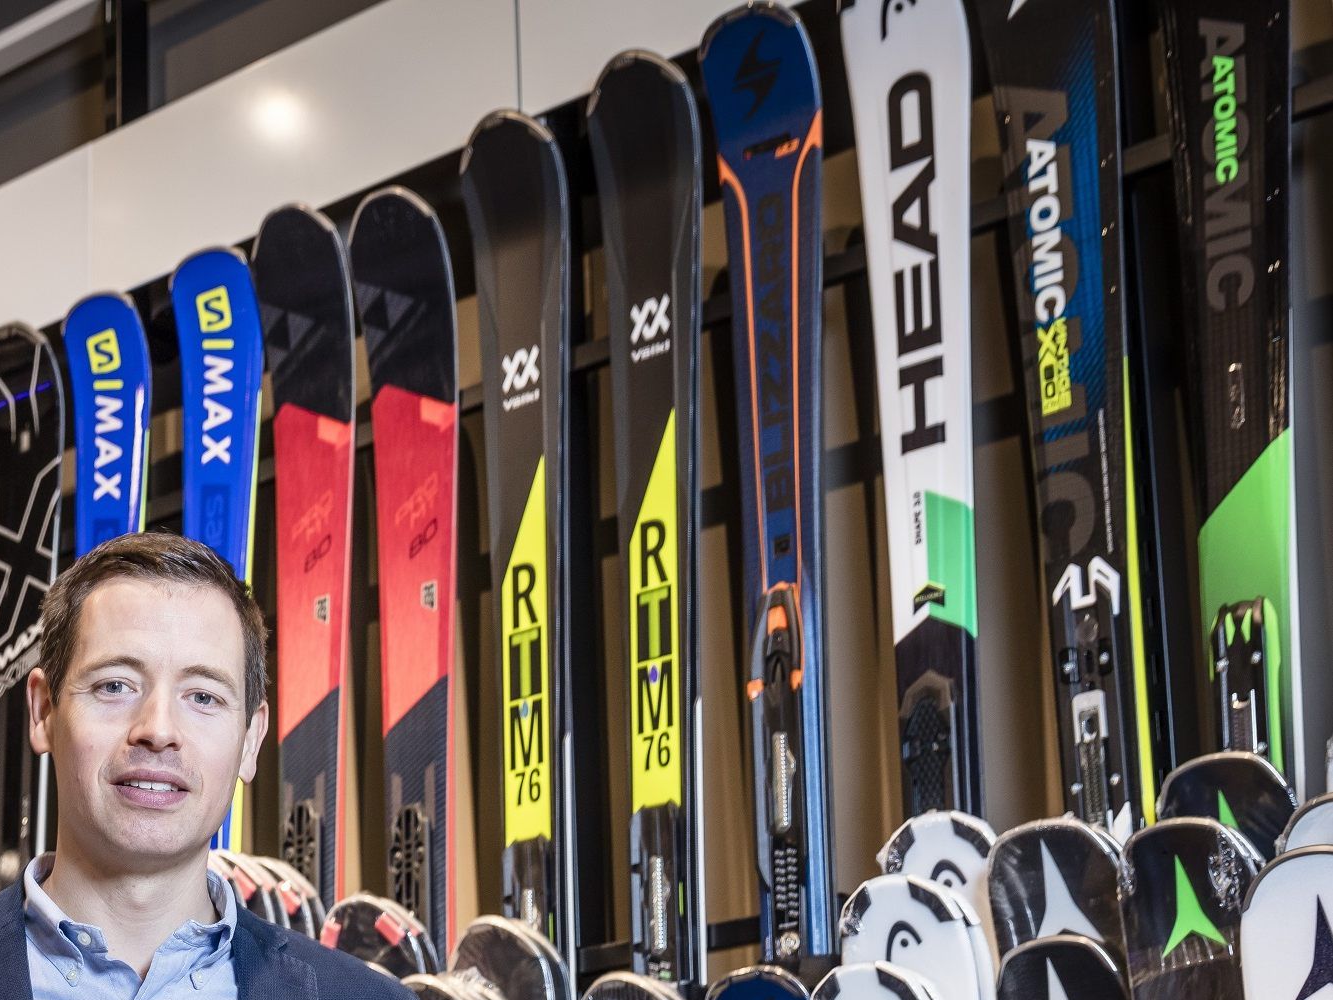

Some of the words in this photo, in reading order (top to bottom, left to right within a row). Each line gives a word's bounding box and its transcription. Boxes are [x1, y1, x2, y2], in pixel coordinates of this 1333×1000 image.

[1212, 55, 1238, 186] ATOMIC
[887, 70, 946, 457] HEAD
[1025, 138, 1067, 323] ATOMIC
[755, 192, 793, 515] BLIZZARD
[304, 534, 332, 573] 80
[410, 518, 438, 560] 80
[509, 562, 542, 771] RTM
[636, 519, 674, 735] RTM
[514, 768, 542, 806] 76
[642, 731, 672, 772] 76
